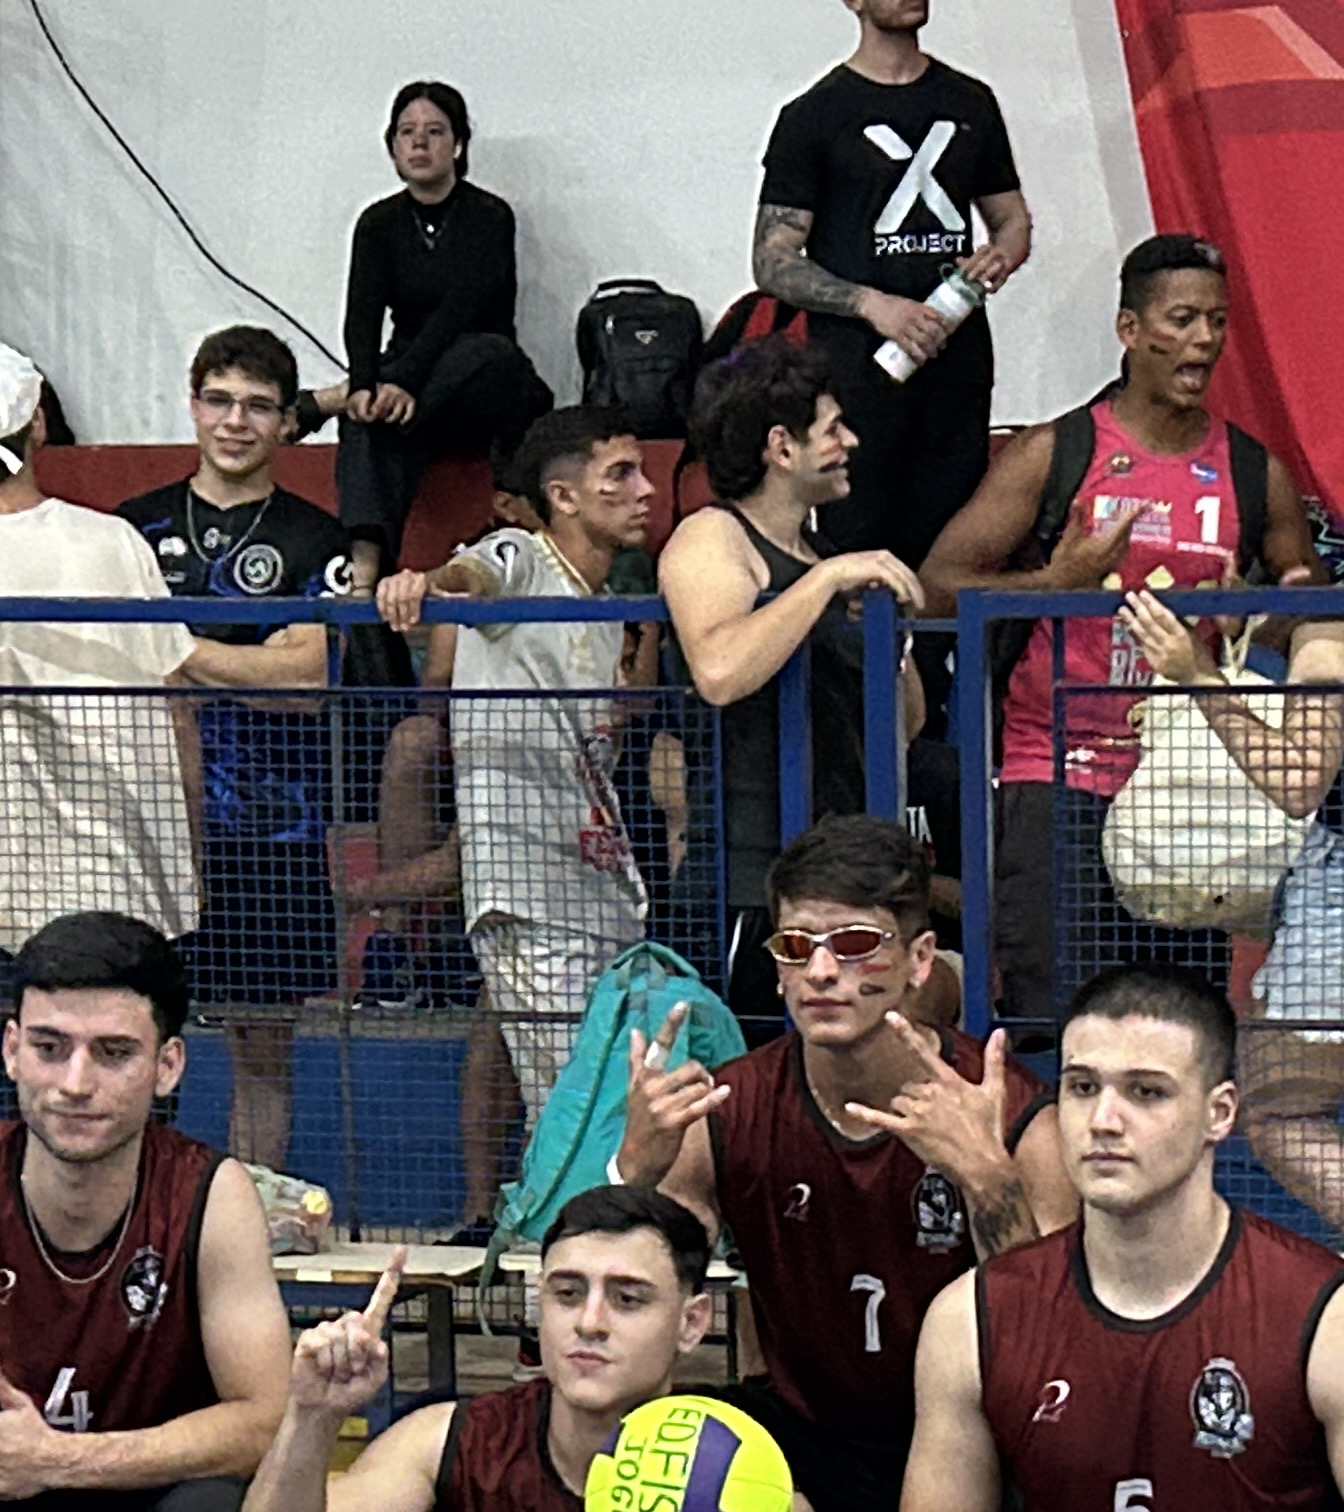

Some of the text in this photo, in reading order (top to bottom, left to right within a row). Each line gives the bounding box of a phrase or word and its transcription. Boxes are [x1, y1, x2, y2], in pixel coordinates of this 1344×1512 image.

[874, 233, 966, 255] PROJECT
[1195, 496, 1221, 544] 1
[850, 1274, 886, 1351] 7
[44, 1367, 94, 1431] 4
